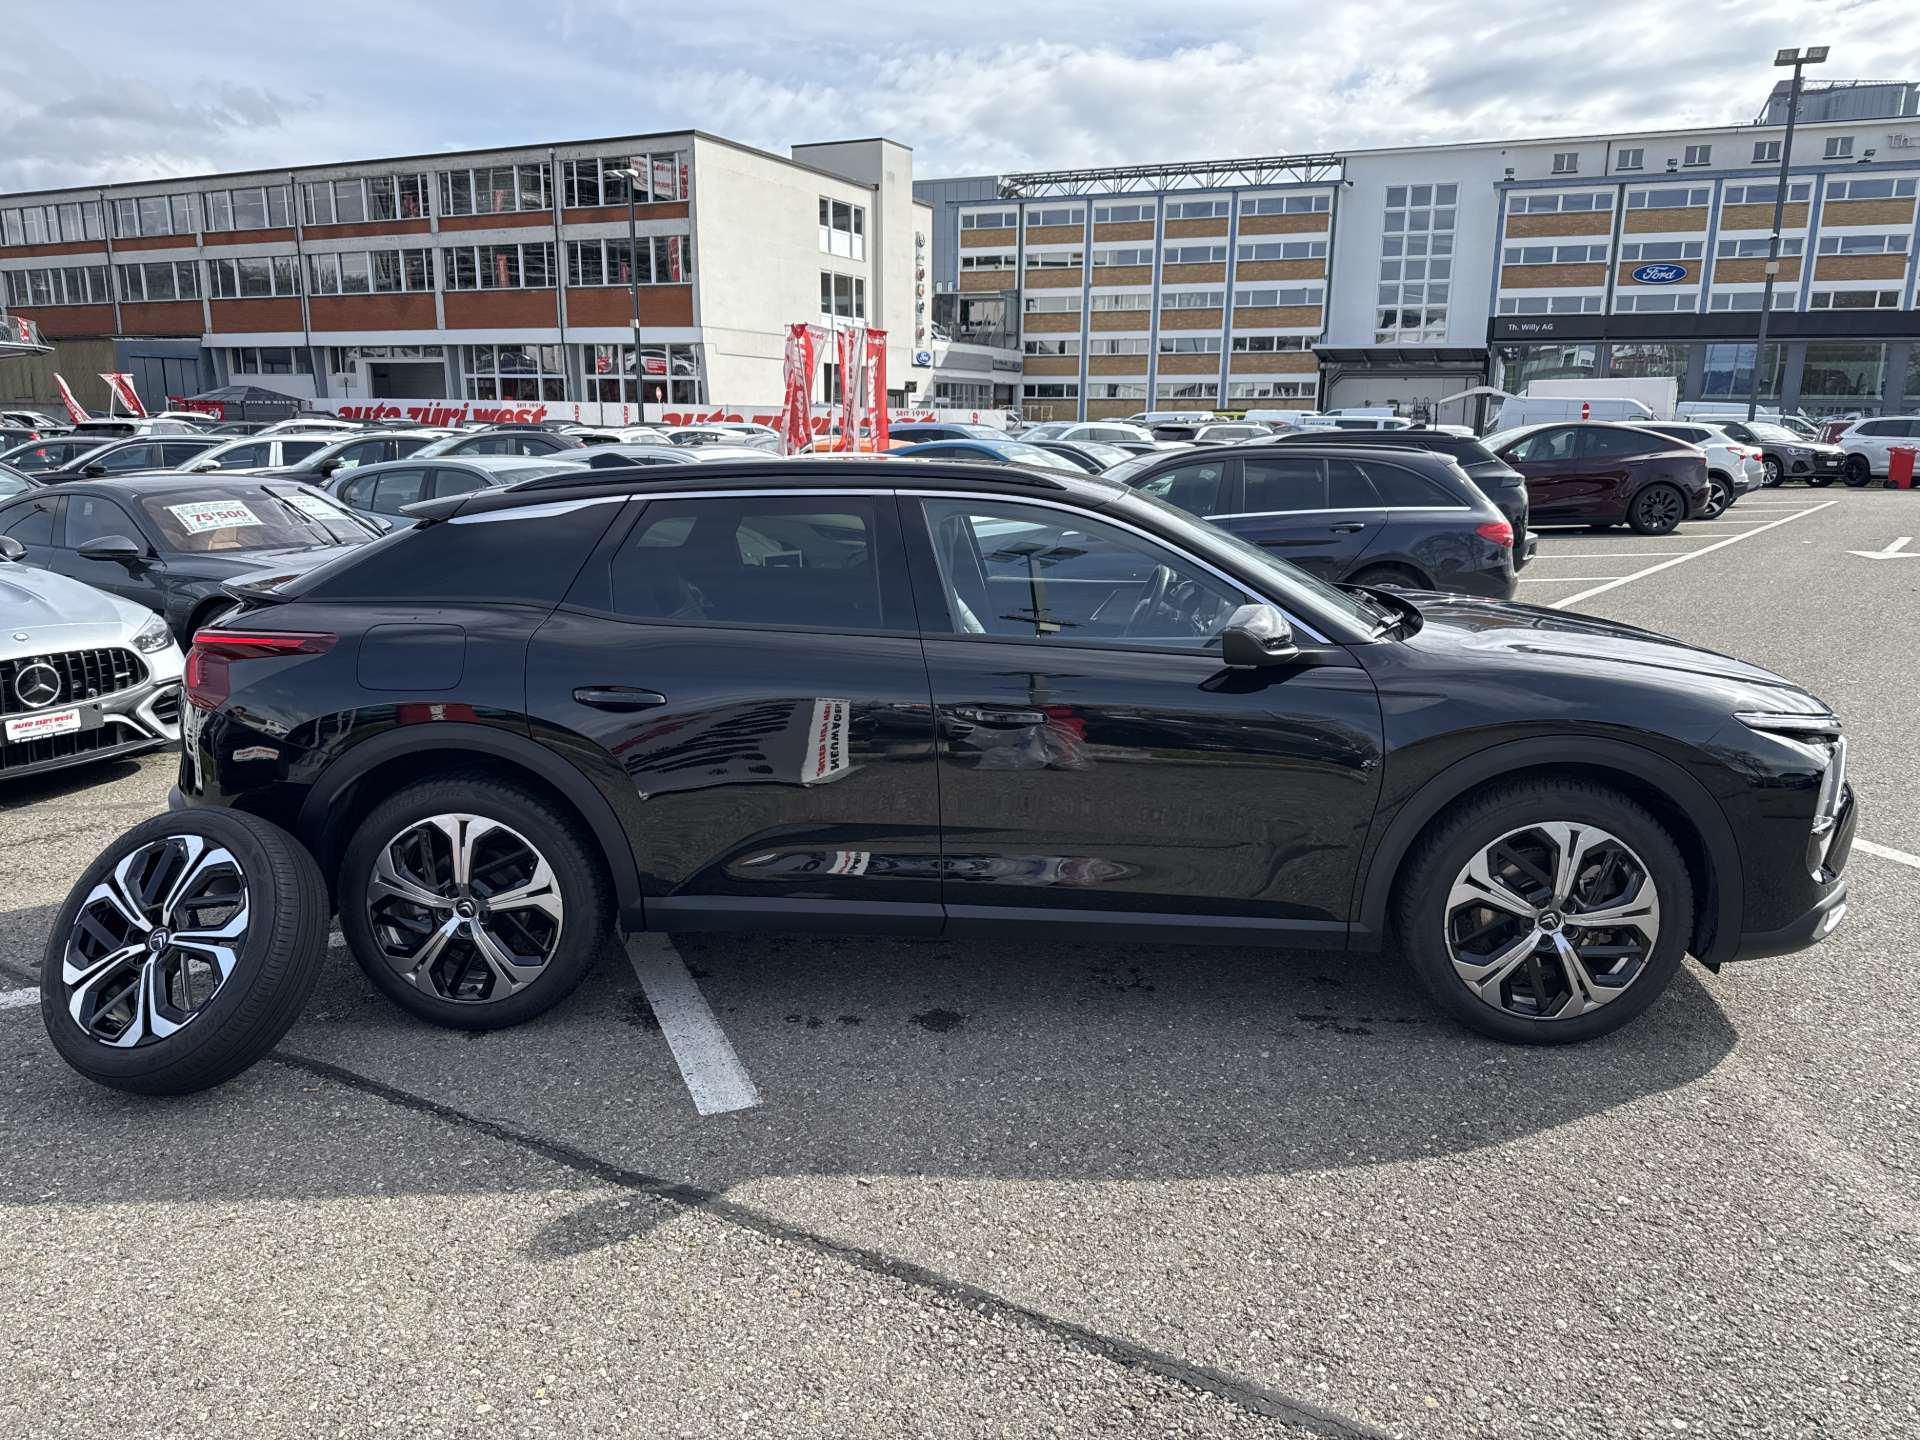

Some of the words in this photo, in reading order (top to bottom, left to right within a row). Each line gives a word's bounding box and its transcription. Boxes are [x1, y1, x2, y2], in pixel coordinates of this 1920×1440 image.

[1642, 266, 1677, 280] Ford
[1508, 323, 1519, 331] Th.
[1521, 323, 1540, 333] Willy
[473, 404, 547, 425] west
[191, 510, 248, 522] 75'500
